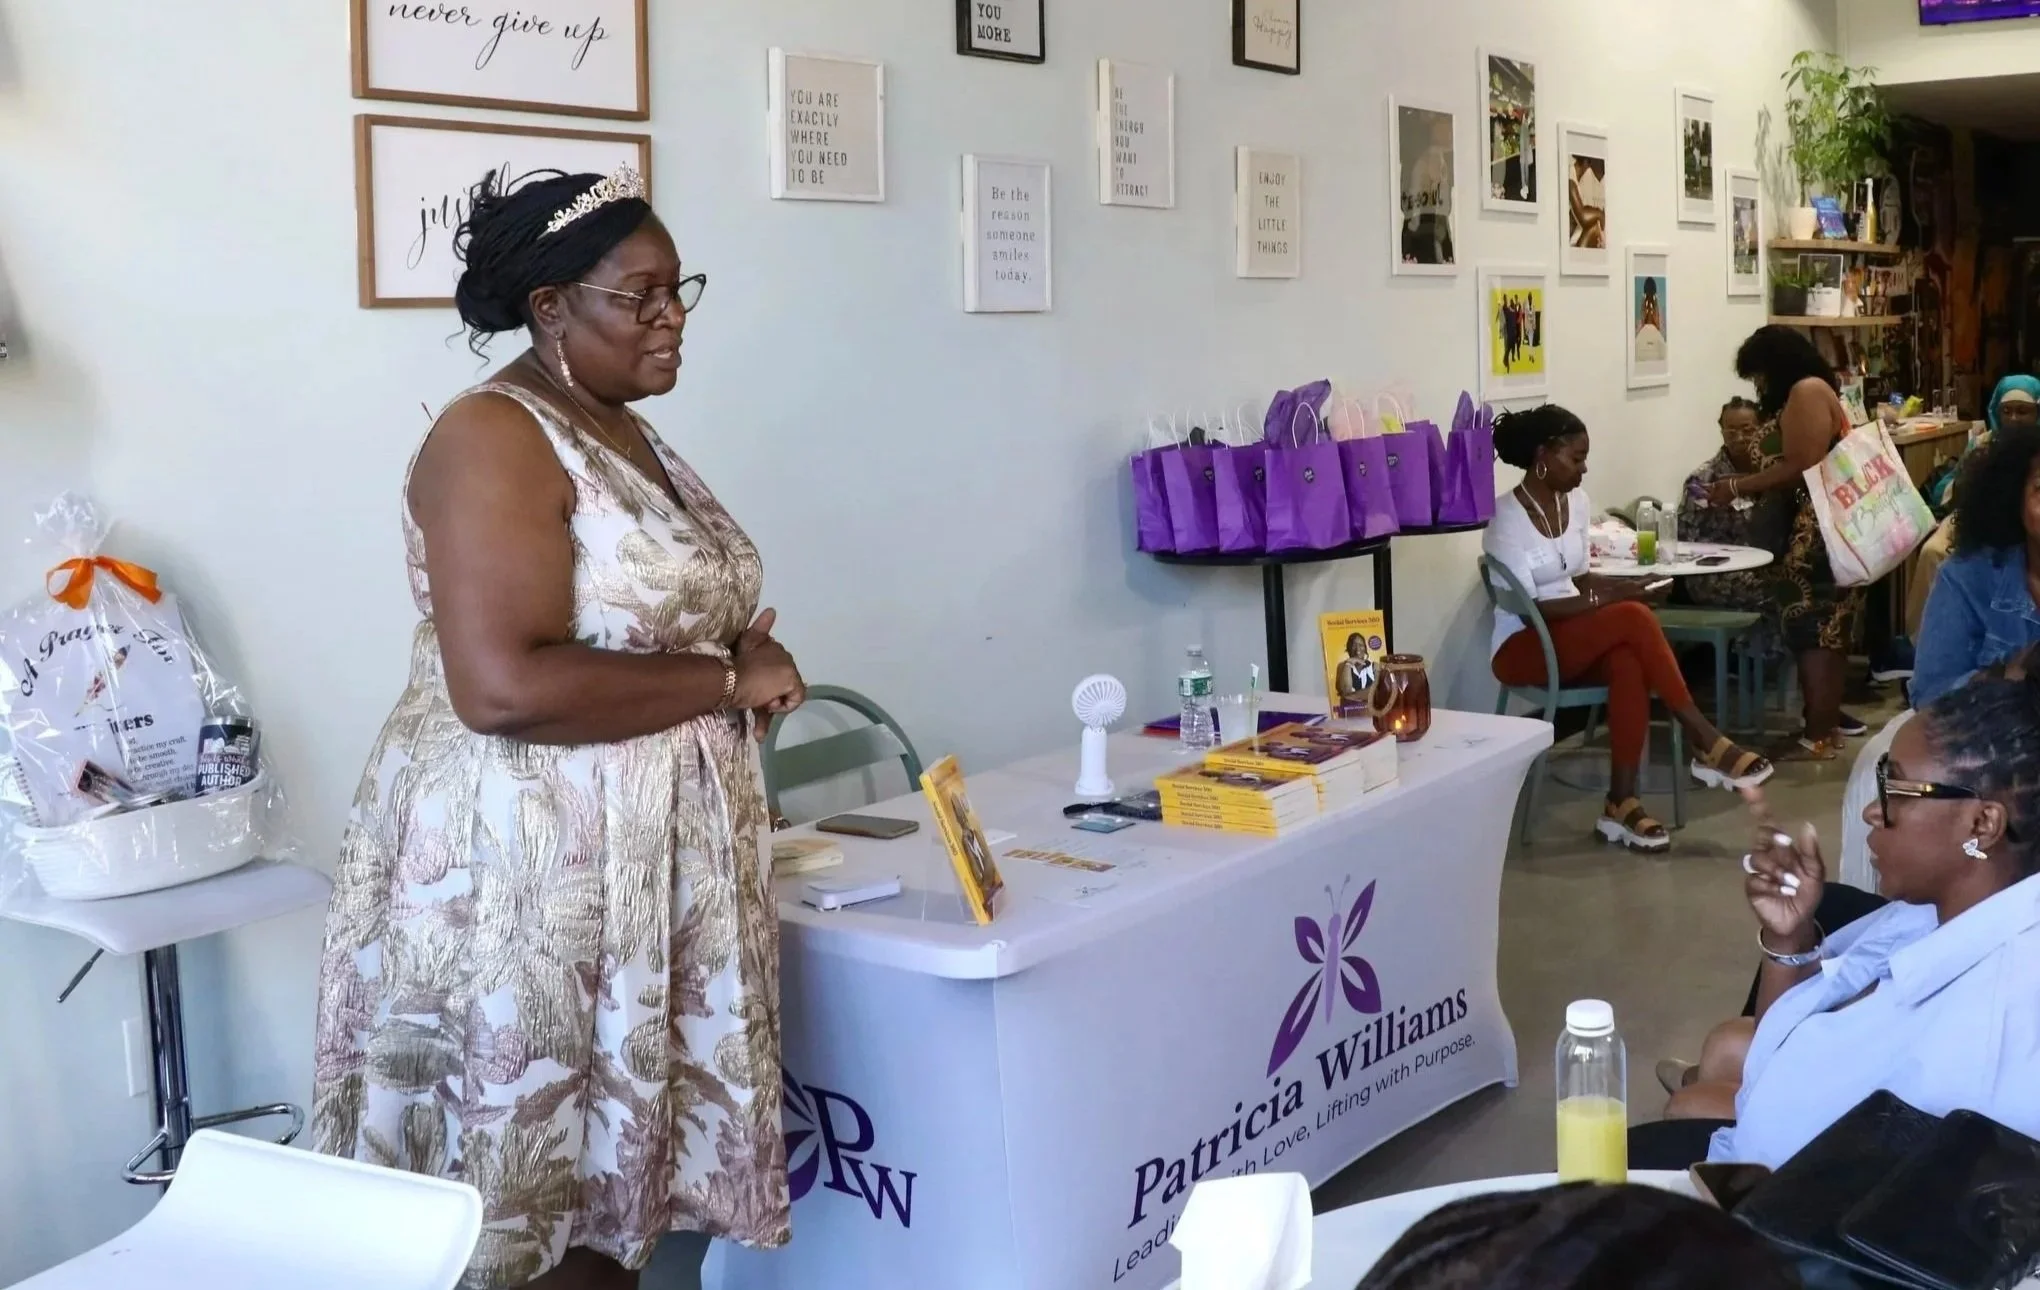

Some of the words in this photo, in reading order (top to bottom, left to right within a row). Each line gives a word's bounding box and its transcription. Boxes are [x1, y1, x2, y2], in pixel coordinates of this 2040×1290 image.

[977, 3, 1001, 20] YOU
[388, 2, 483, 26] never
[474, 11, 553, 71] give
[563, 16, 612, 71] up
[977, 24, 1011, 43] MORE
[791, 89, 812, 105] YOU
[818, 92, 840, 108] ARE
[790, 109, 839, 128] EXACTLY
[790, 129, 829, 146] WHERE
[1114, 135, 1129, 148] YOU
[791, 149, 813, 165] YOU
[818, 151, 847, 167] NEED
[1115, 151, 1137, 165] WANT
[791, 168, 804, 183] TO
[811, 169, 825, 184] BE
[1258, 171, 1286, 187] ENJOY
[991, 186, 1006, 200] Be
[1010, 187, 1030, 201] the
[1115, 183, 1148, 197] ATTRACT
[1264, 194, 1280, 208] THE
[991, 209, 1031, 221] reason
[1258, 218, 1287, 231] LITTLE
[986, 229, 1036, 241] someone
[991, 247, 1030, 261] smiles
[1257, 240, 1289, 255] THINGS
[21, 657, 39, 697] A
[197, 763, 252, 777] PUBLISHED
[201, 774, 242, 787] AUTHOR
[1128, 1076, 1304, 1229] Patricia
[1315, 987, 1469, 1092] Williams
[1113, 1213, 1180, 1284] Leadi
[1263, 1125, 1311, 1166] Love,
[1316, 1083, 1371, 1131] Lifting
[1375, 1062, 1411, 1096] with
[1415, 1033, 1476, 1078] Purpose.
